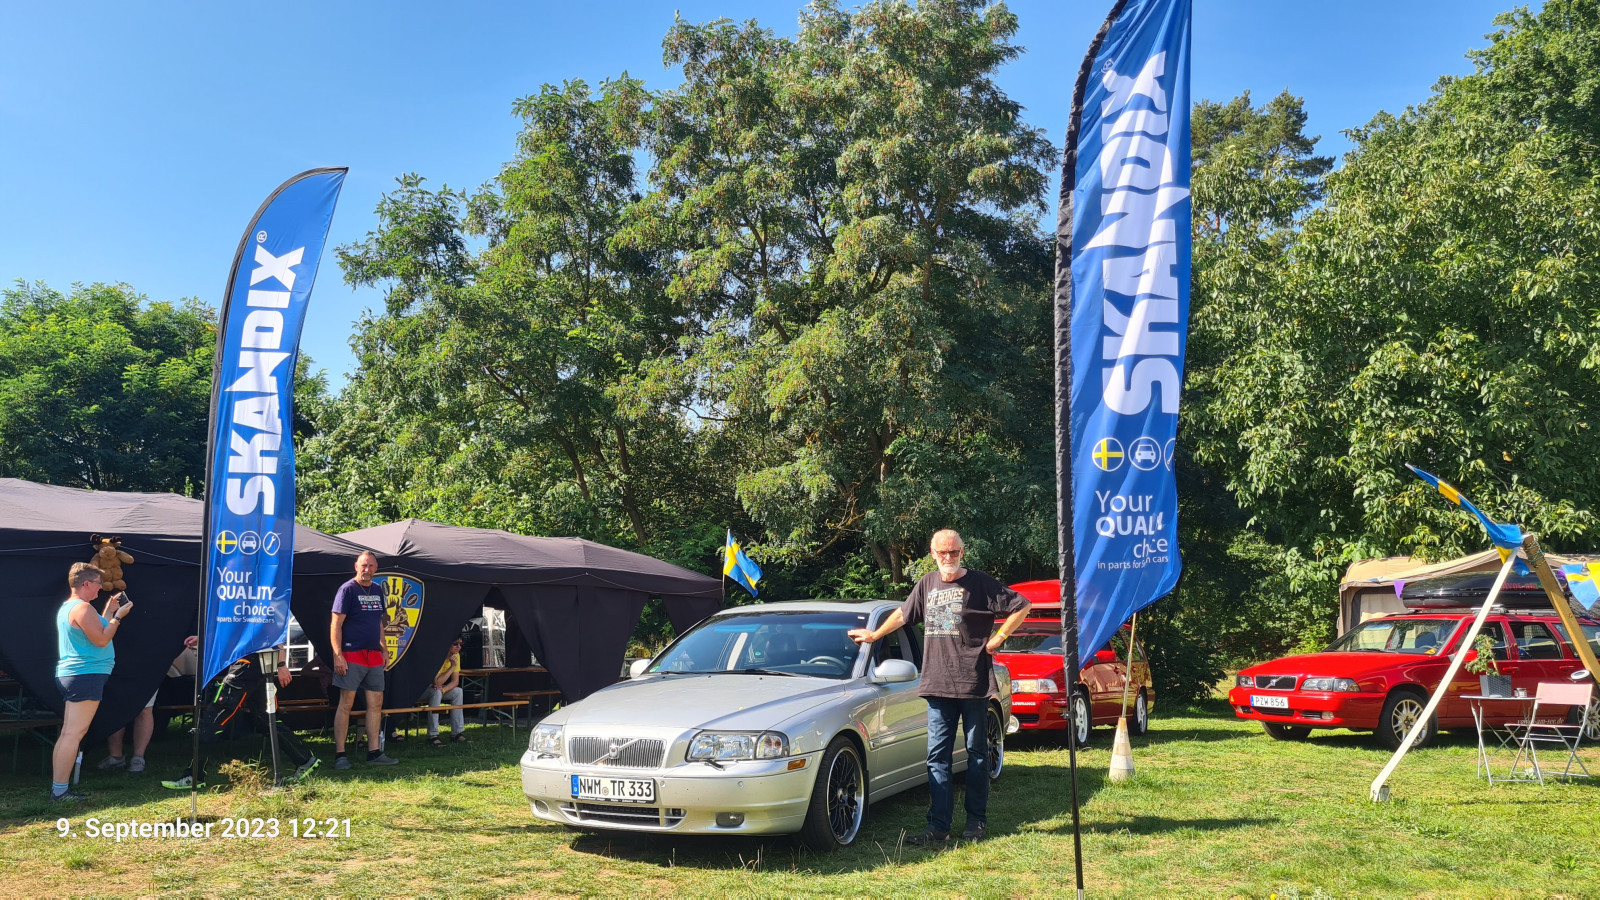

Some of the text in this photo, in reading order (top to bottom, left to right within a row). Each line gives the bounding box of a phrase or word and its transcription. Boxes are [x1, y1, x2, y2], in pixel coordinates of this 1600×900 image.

[1079, 50, 1190, 415] SKANDIX
[224, 244, 305, 516] SKANDIX
[1095, 490, 1153, 513] Your
[1097, 561, 1106, 569] in
[1108, 562, 1131, 571] parts
[1132, 560, 1141, 569] for
[1152, 555, 1169, 563] cars
[216, 566, 252, 584] Your
[216, 584, 277, 601] QUALITY
[381, 578, 418, 606] OLVO
[233, 601, 275, 616] choice
[1255, 696, 1285, 707] PZW 856
[579, 777, 652, 798] NWM TR 333
